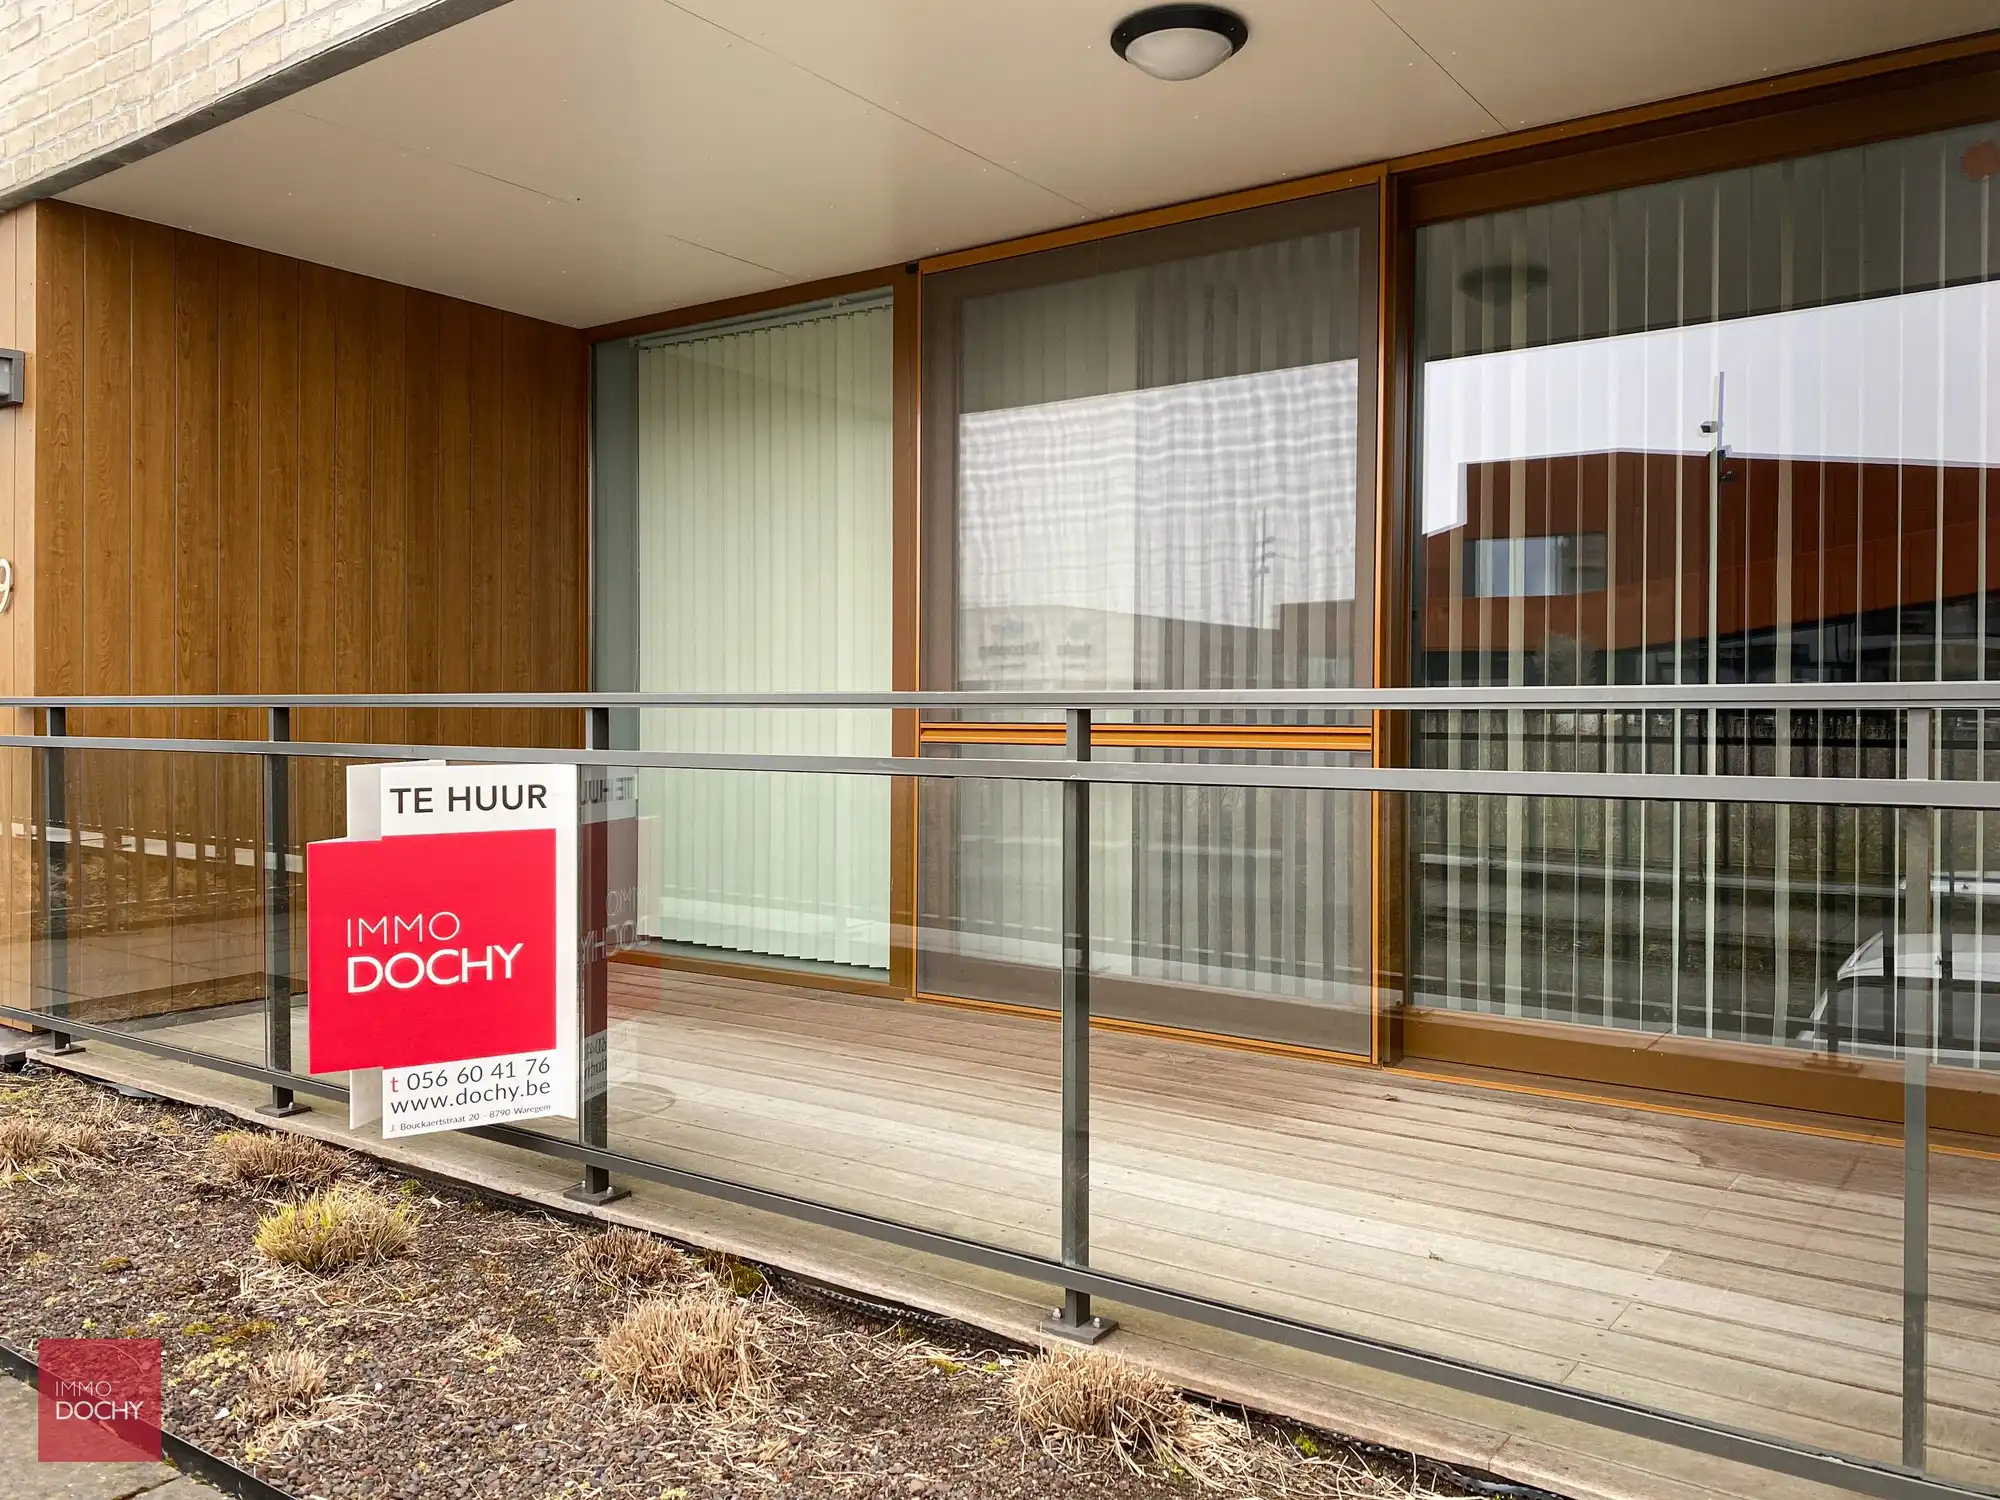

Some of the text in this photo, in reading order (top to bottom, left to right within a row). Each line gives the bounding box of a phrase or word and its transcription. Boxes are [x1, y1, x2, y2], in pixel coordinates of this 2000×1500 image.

[389, 784, 547, 814] TE HUUR
[346, 911, 461, 948] IMMO
[347, 942, 524, 994] DOCHY
[389, 1057, 551, 1093] t 056 60 41 76
[390, 1079, 551, 1114] www.dochy.be
[400, 1115, 466, 1131] Bouckaertstraat
[469, 1113, 480, 1122] 20
[489, 1109, 511, 1119] 8790
[513, 1104, 551, 1115] Waregem
